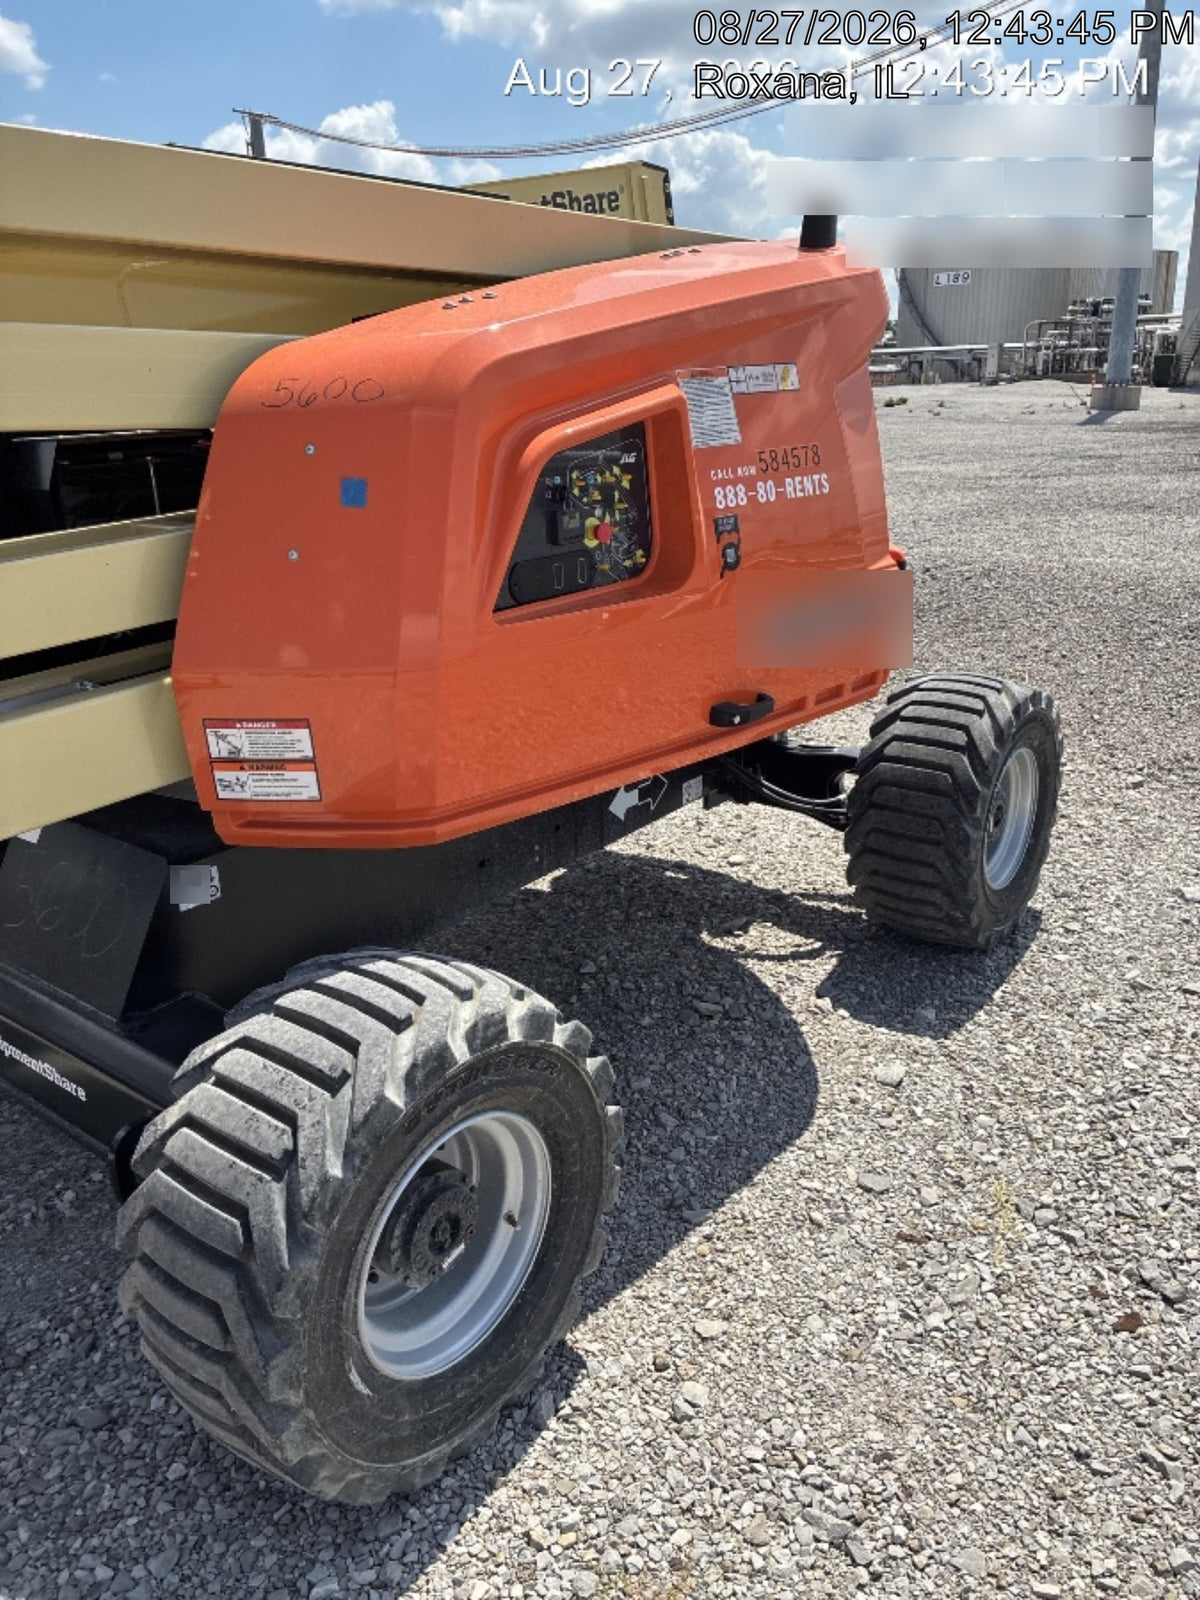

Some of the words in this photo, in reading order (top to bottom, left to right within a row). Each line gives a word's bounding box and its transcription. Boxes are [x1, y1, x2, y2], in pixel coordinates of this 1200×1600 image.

[534, 188, 621, 214] tShare
[260, 376, 384, 408] 5600
[710, 466, 734, 480] CALL
[757, 444, 821, 474] 584578
[714, 473, 830, 510] 888-80-RENTS
